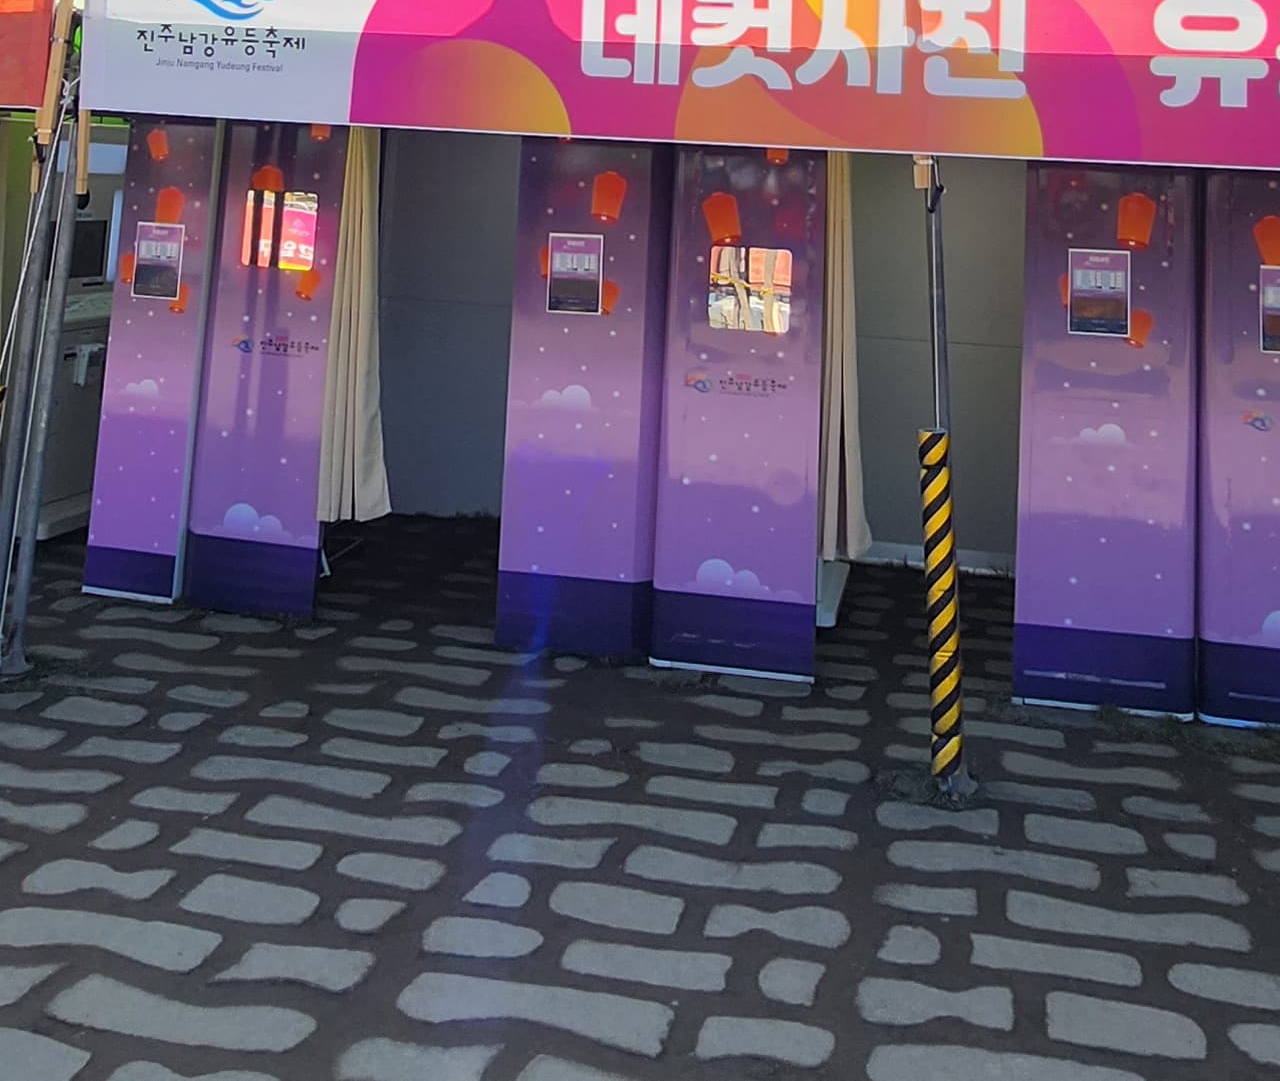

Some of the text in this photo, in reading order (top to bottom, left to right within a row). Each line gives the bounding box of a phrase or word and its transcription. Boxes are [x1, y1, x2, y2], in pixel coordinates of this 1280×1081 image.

[136, 24, 306, 58] 진주남강유등축제
[177, 58, 214, 71] Namgang
[252, 62, 284, 72] Festival
